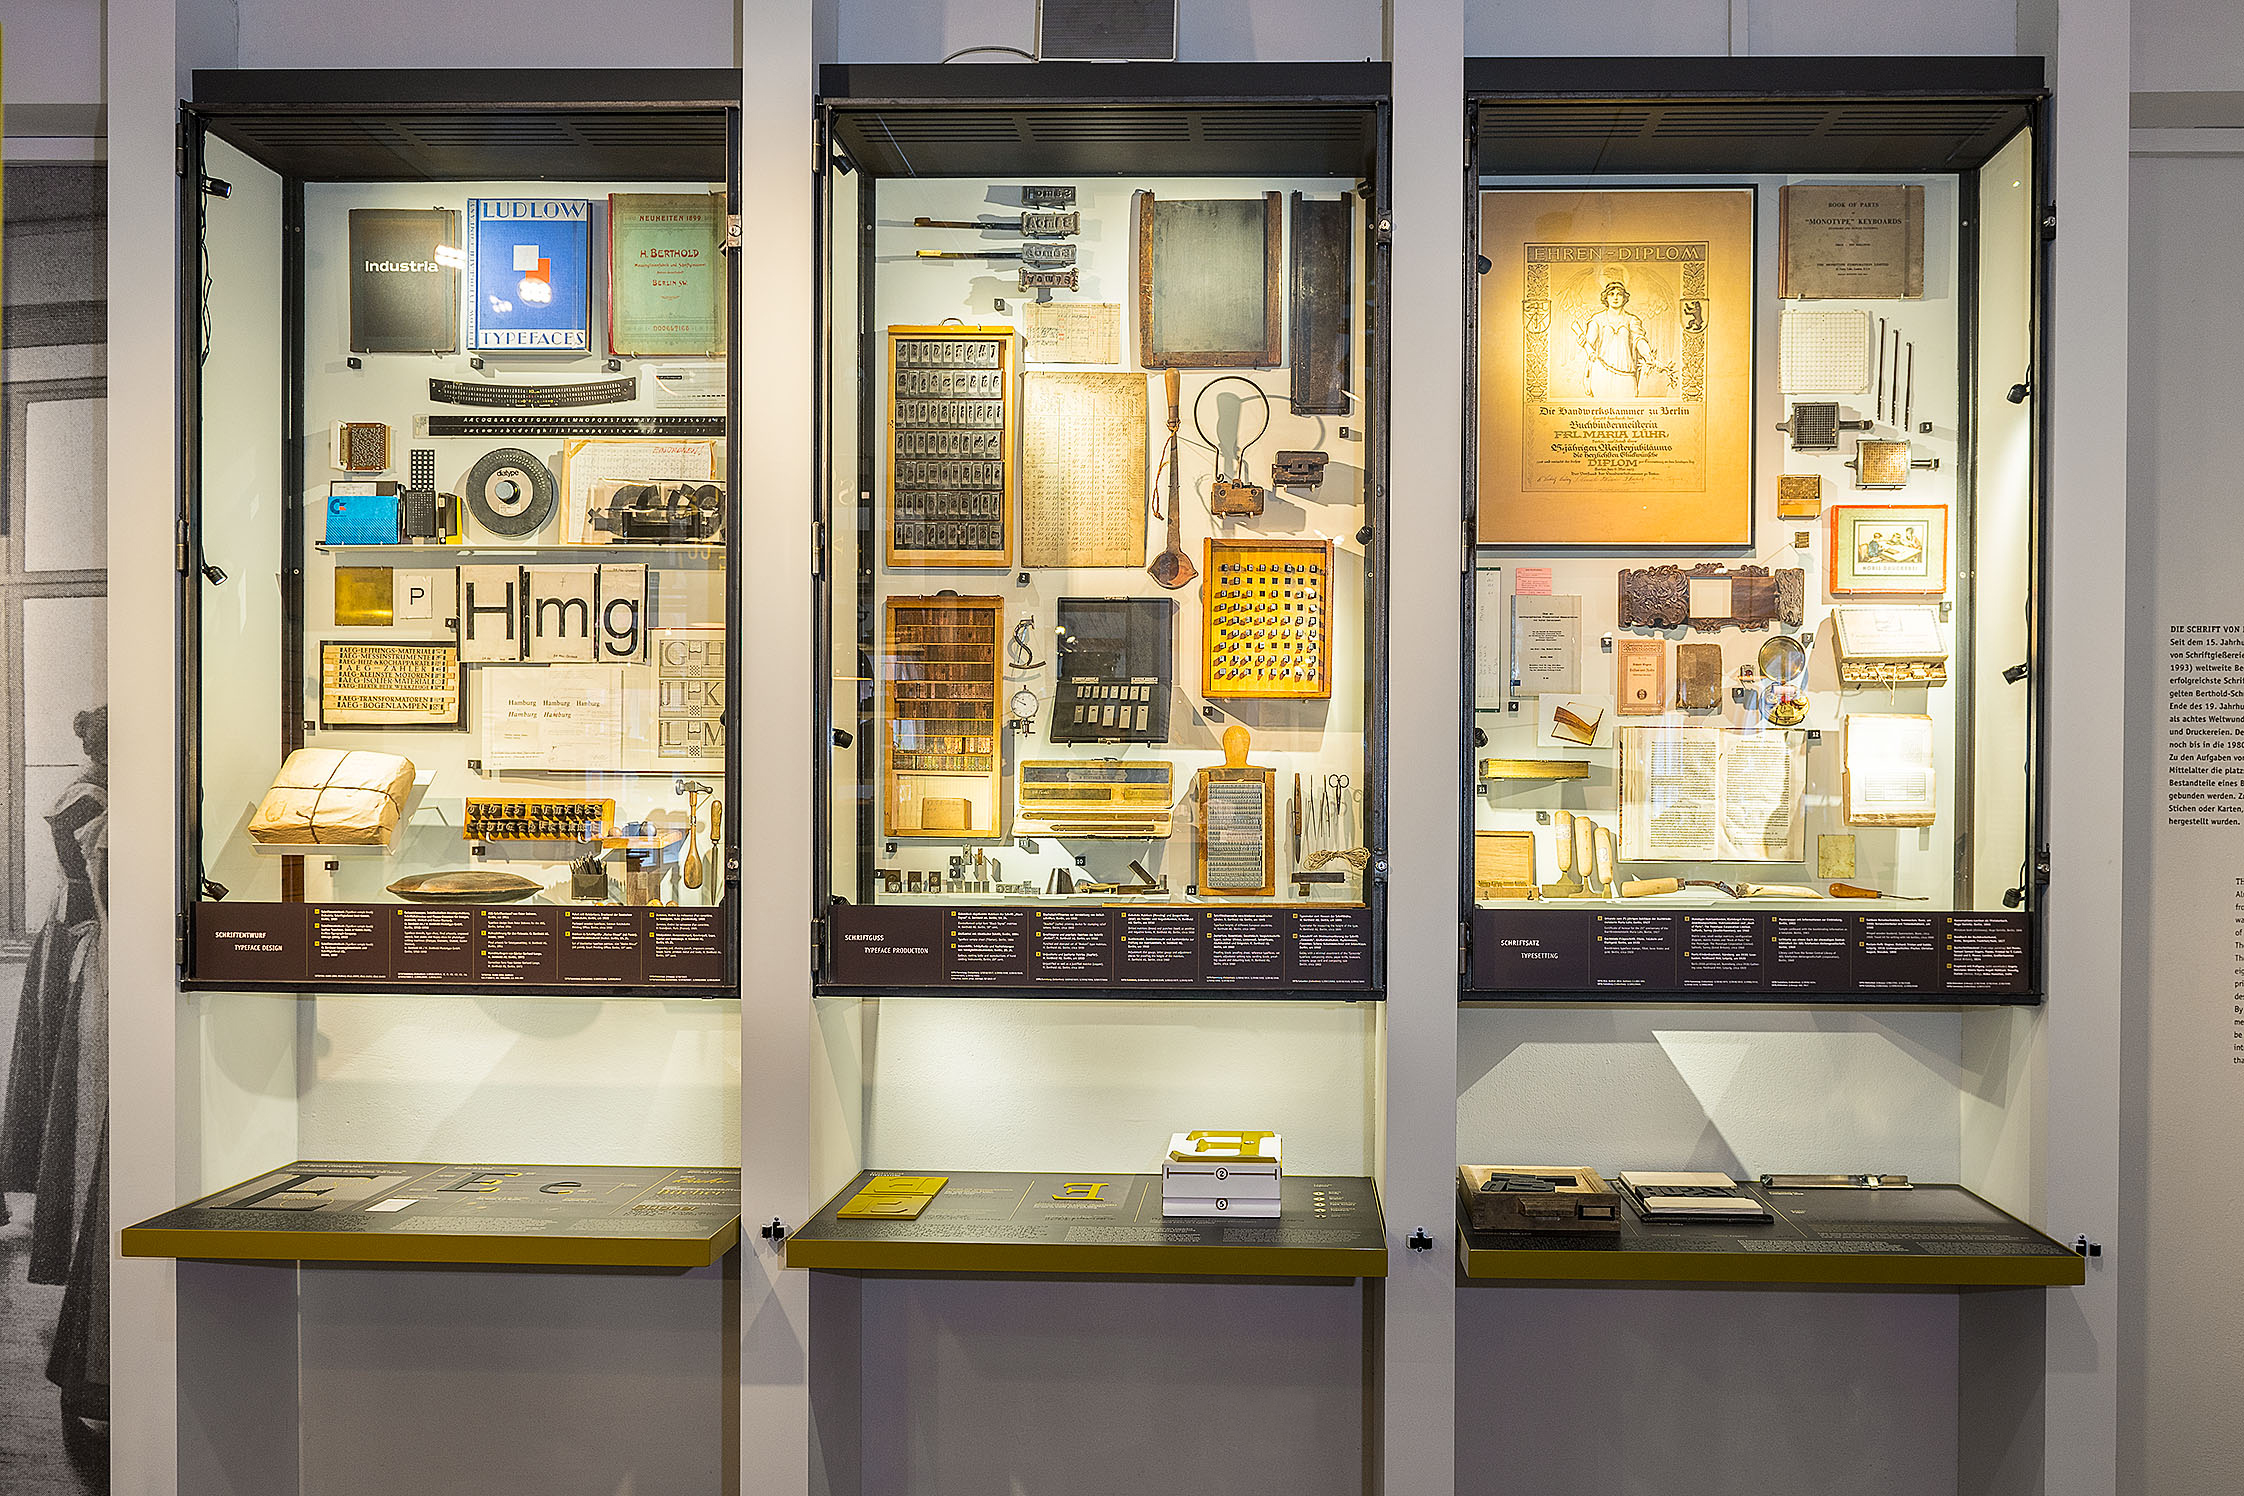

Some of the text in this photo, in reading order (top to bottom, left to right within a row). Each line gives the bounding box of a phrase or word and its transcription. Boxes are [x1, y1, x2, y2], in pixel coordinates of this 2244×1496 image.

[483, 201, 585, 218] LUDLOW
[650, 248, 699, 258] BERTHOLD
[481, 332, 584, 345] TYPEFACES
[1539, 407, 1556, 415] Die
[1660, 406, 1690, 415] Berlin
[1583, 431, 1629, 439] MARIA
[1587, 459, 1638, 467] DIPLOM
[410, 587, 424, 605] P
[466, 582, 639, 656] H m g
[2170, 625, 2241, 633] DIE SCHRIFT VON
[2170, 638, 2186, 646] Seit
[2187, 638, 2204, 646] dem
[2206, 638, 2218, 646] 15.
[665, 641, 687, 665] G
[2170, 664, 2193, 673] 1993)
[2195, 664, 2232, 672] weltweite
[2169, 677, 2222, 686] erfolgreichste
[704, 682, 721, 705] K
[2169, 690, 2194, 699] gelten
[508, 711, 572, 719] Hamburg Hamburg
[665, 722, 681, 745] L
[2189, 741, 2201, 749] bis
[2203, 741, 2211, 749] in
[2212, 741, 2225, 749] die
[2196, 754, 2232, 763] Aufgaben
[2168, 793, 2205, 801] gebunden
[2217, 805, 2244, 813] Karten,
[2168, 818, 2209, 826] hergestellt
[2235, 928, 2243, 936] of
[2234, 1005, 2244, 1014] By
